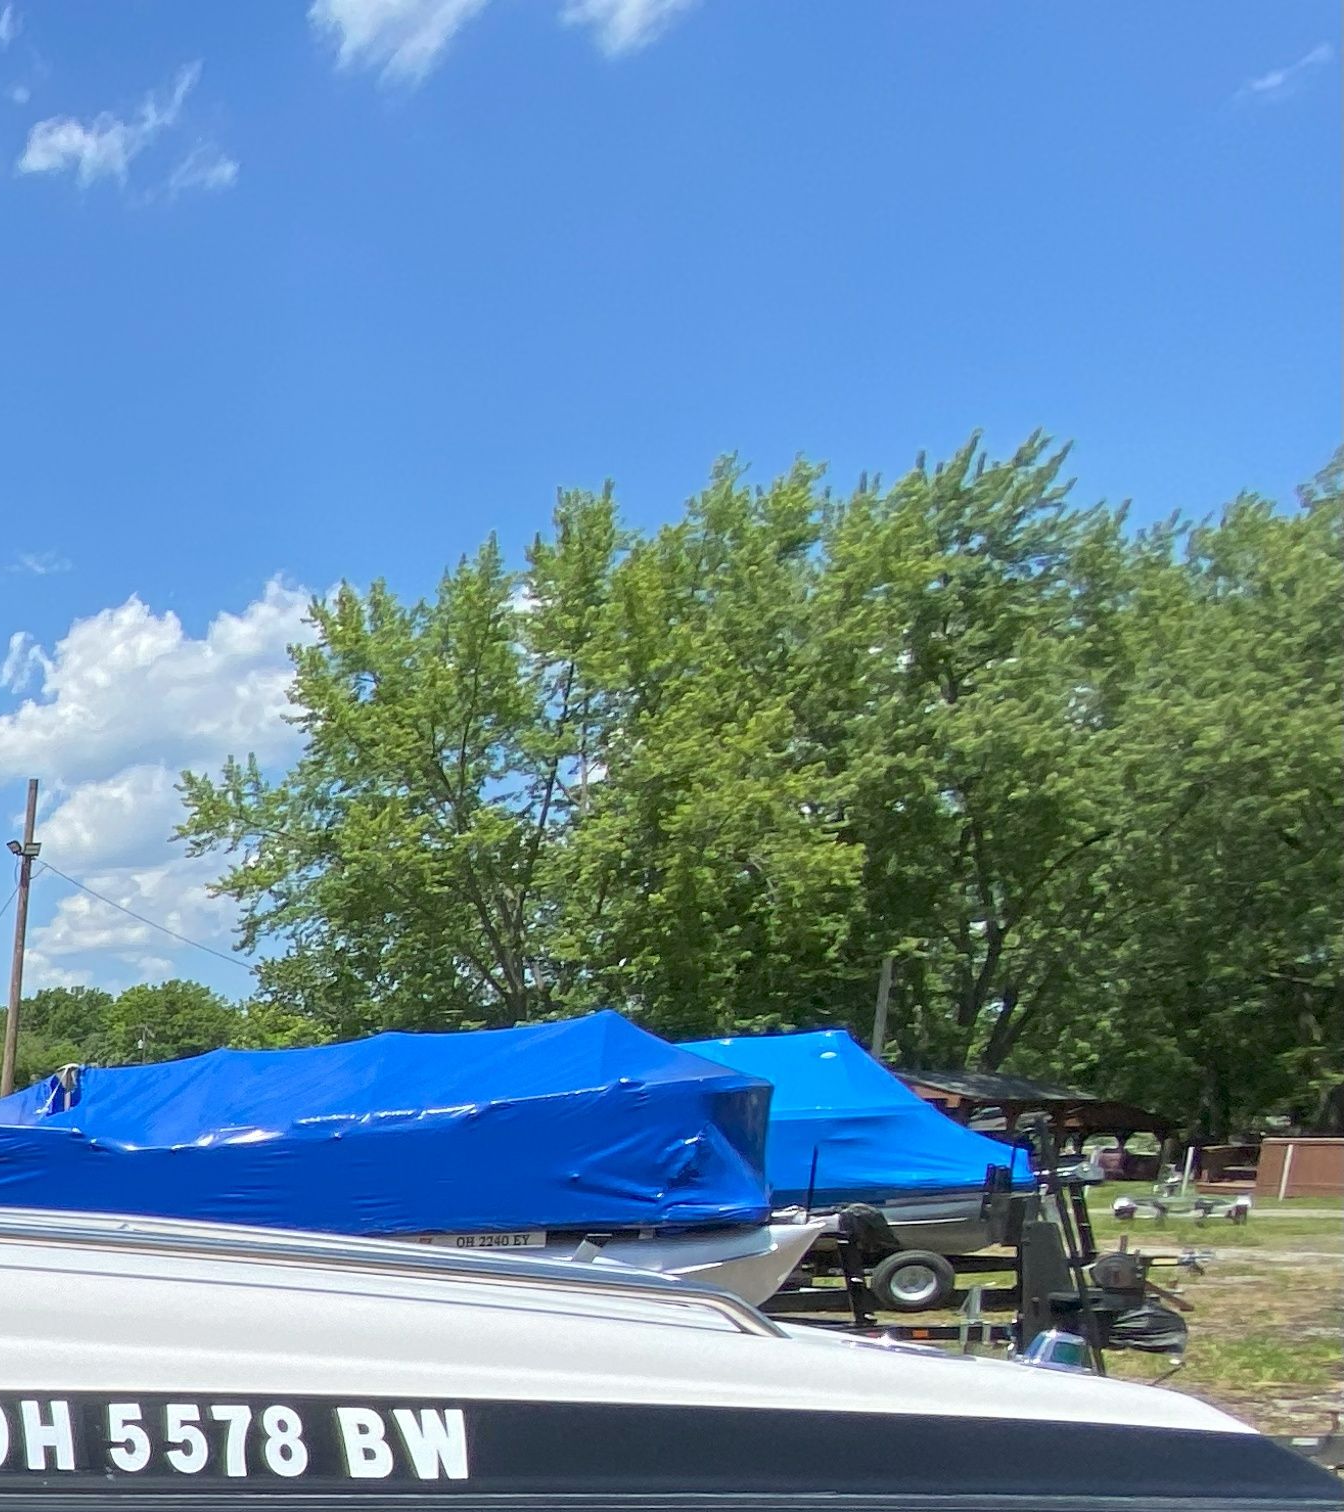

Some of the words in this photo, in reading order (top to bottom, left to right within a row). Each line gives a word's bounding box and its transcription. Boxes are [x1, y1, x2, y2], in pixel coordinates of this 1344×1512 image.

[456, 1236, 474, 1248] OH
[478, 1235, 509, 1247] 2240
[513, 1233, 530, 1245] EY
[108, 1403, 309, 1477] 5578
[336, 1407, 469, 1479] BW
